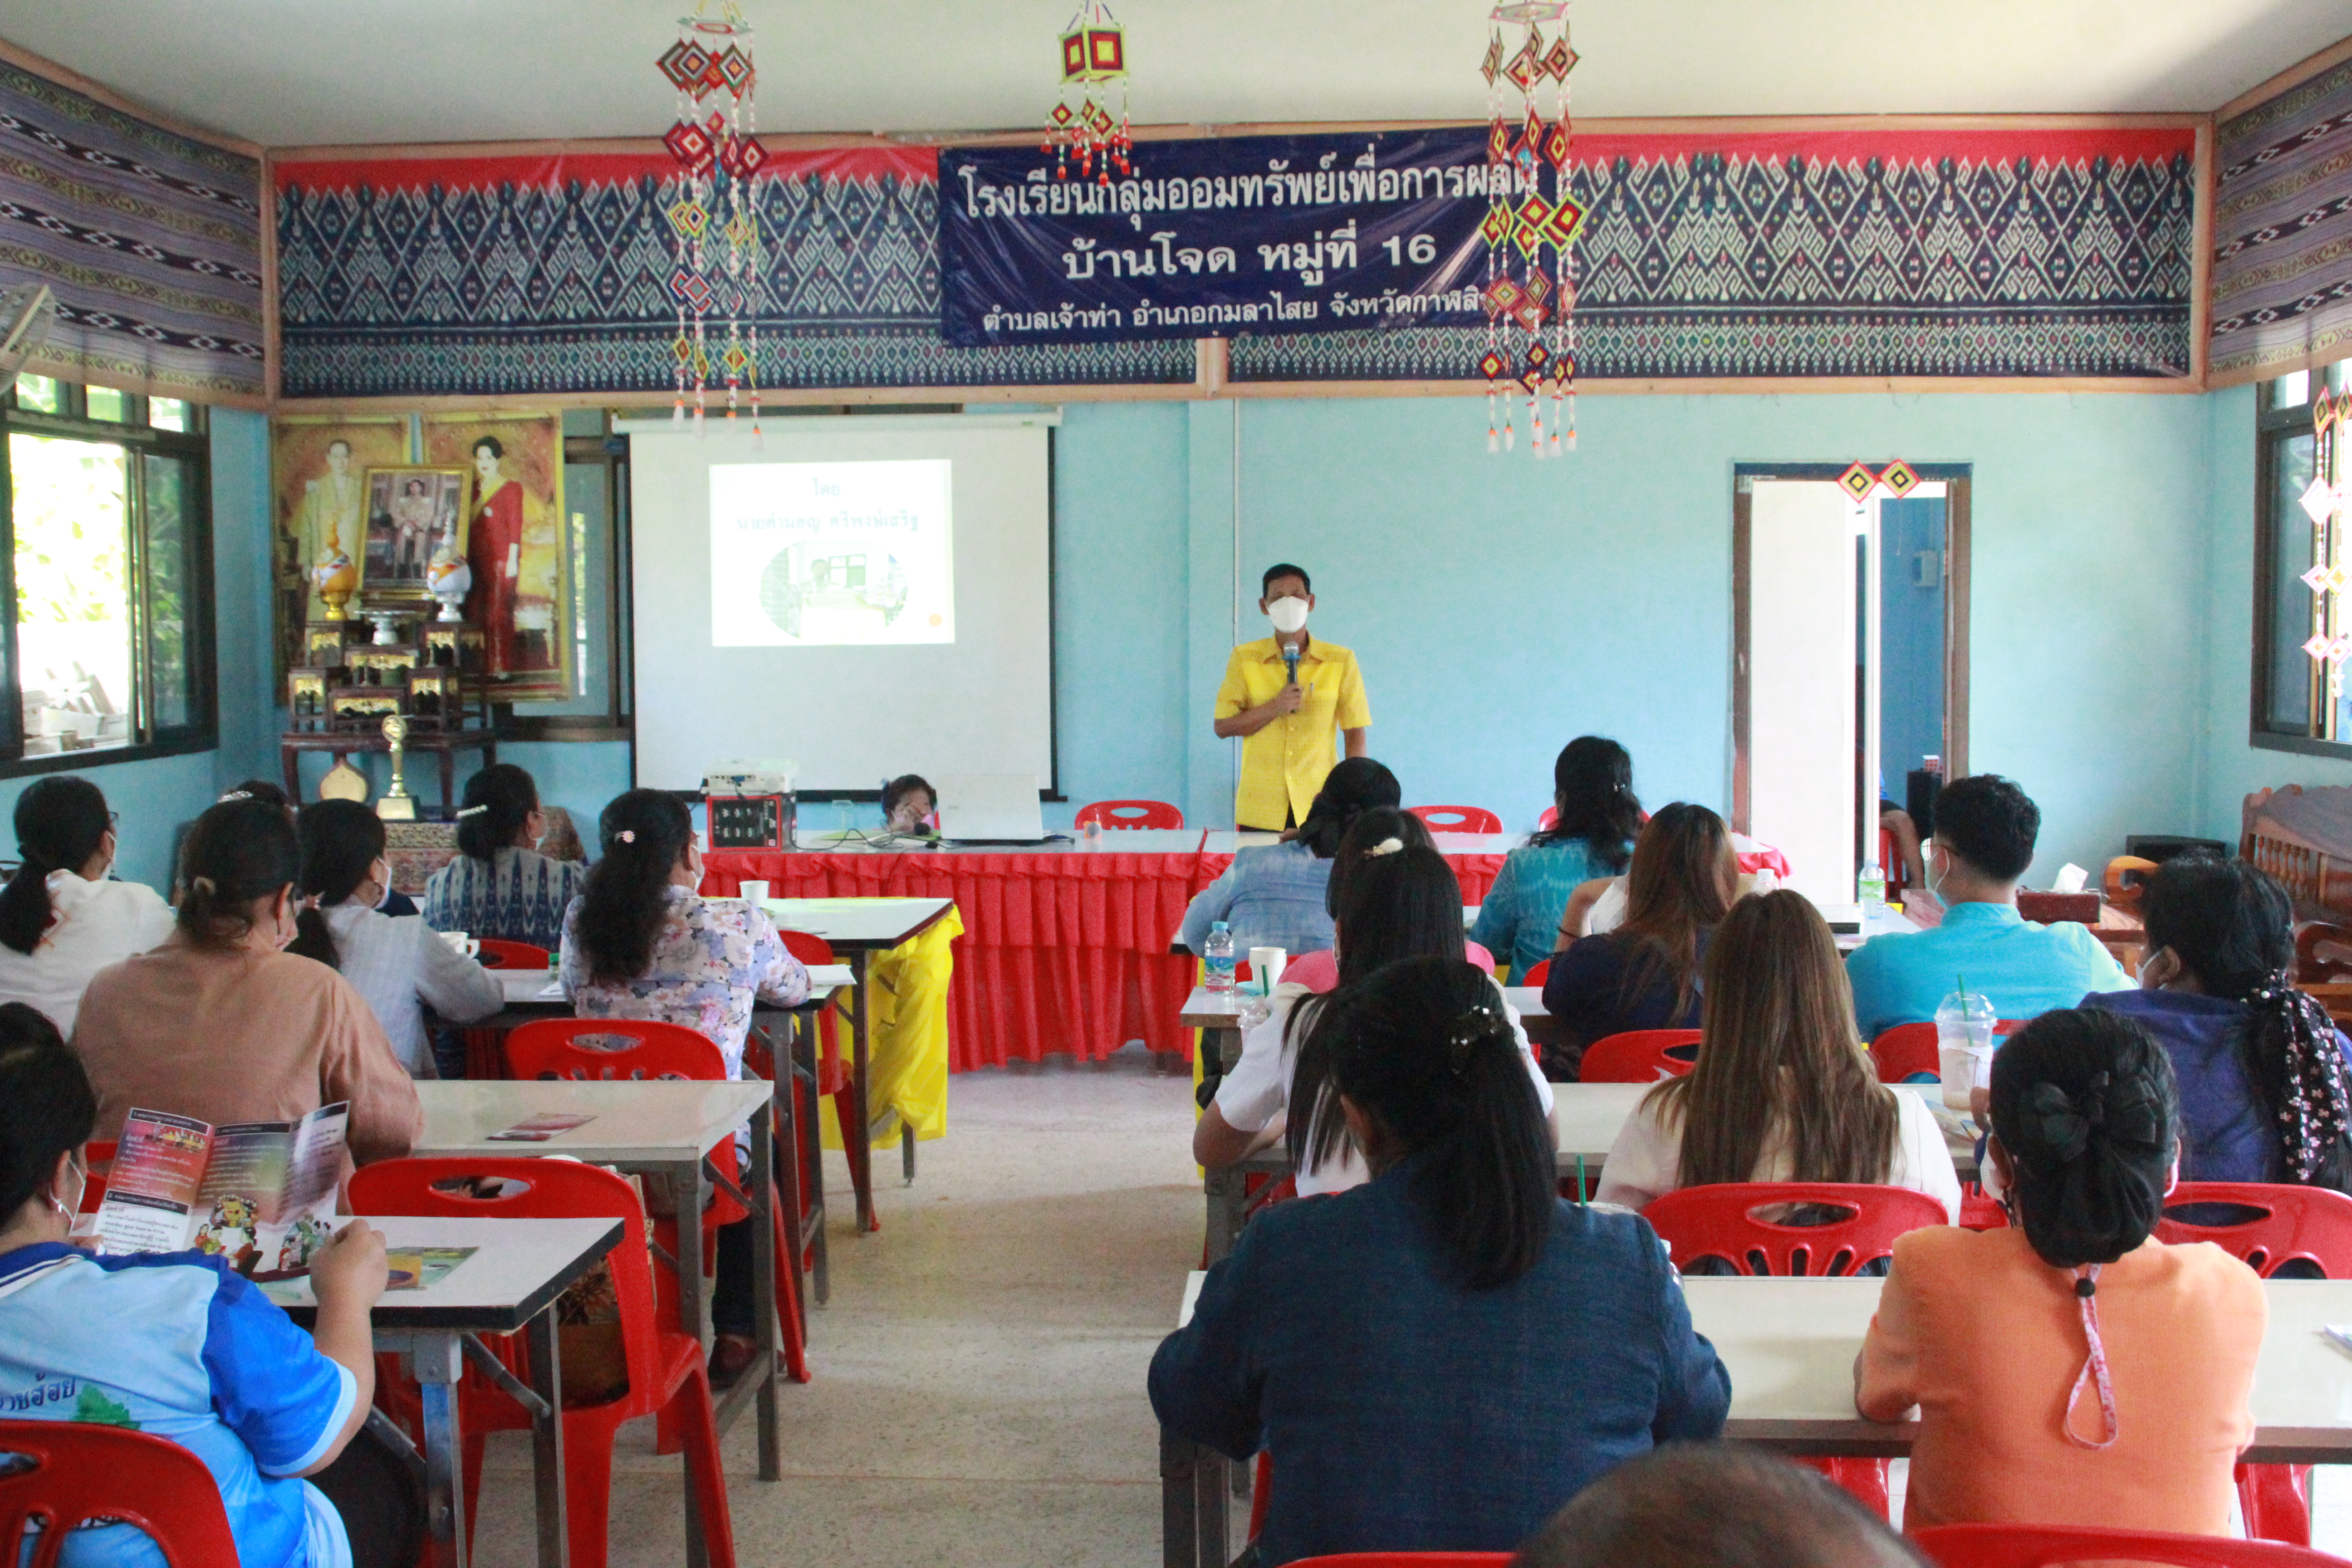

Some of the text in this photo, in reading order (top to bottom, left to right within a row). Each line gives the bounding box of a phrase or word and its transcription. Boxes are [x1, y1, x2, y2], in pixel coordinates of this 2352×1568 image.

[1062, 218, 1437, 286] บ้านโจด หมู่ที่ 16
[983, 302, 1121, 332] ตำบลเจ้าท่า
[1132, 290, 1318, 327] อำเภอกมลาไสย
[0, 1371, 76, 1410] ายฮ้อย
